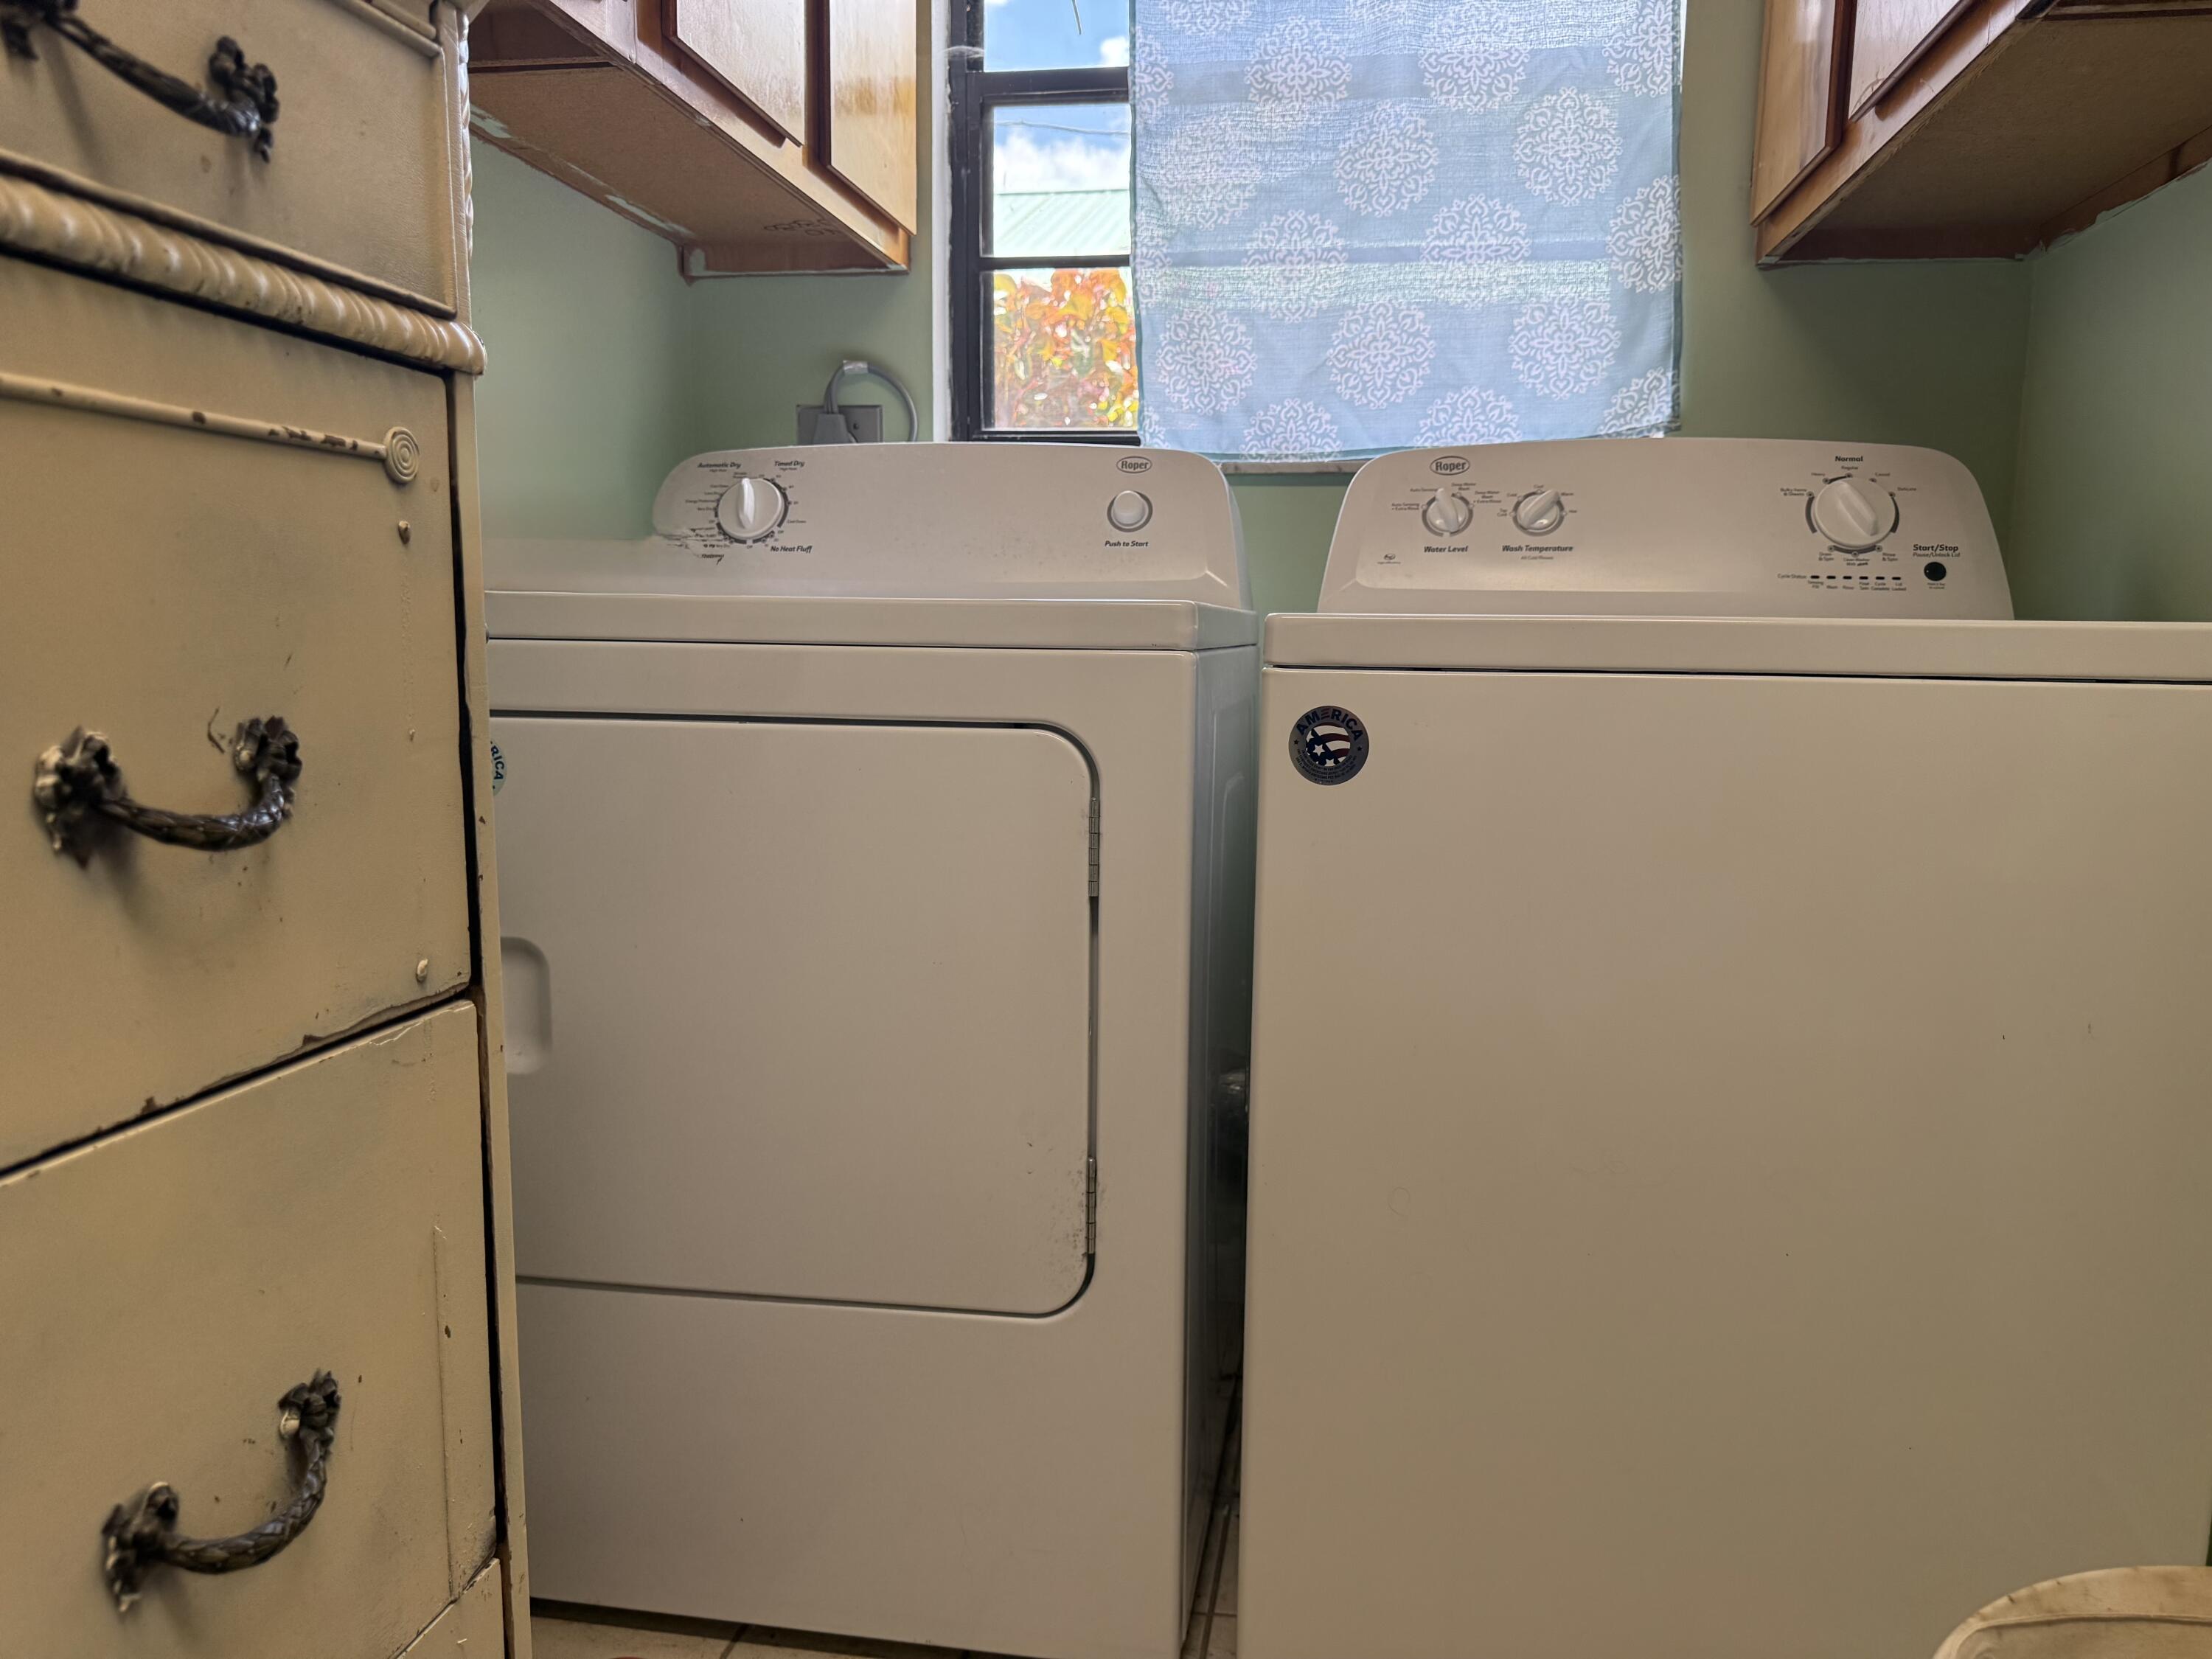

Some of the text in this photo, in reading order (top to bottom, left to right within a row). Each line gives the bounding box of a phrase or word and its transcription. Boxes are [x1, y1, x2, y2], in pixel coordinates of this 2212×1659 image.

[729, 462, 742, 470] Dry
[1121, 460, 1149, 470] Roper
[1435, 462, 1467, 472] Roper
[796, 546, 813, 554] Fluff
[1525, 544, 1573, 554] Temperature
[1913, 544, 1959, 553] Start/Stop
[1296, 708, 1363, 741] AMERICA
[490, 741, 505, 779] RICA
